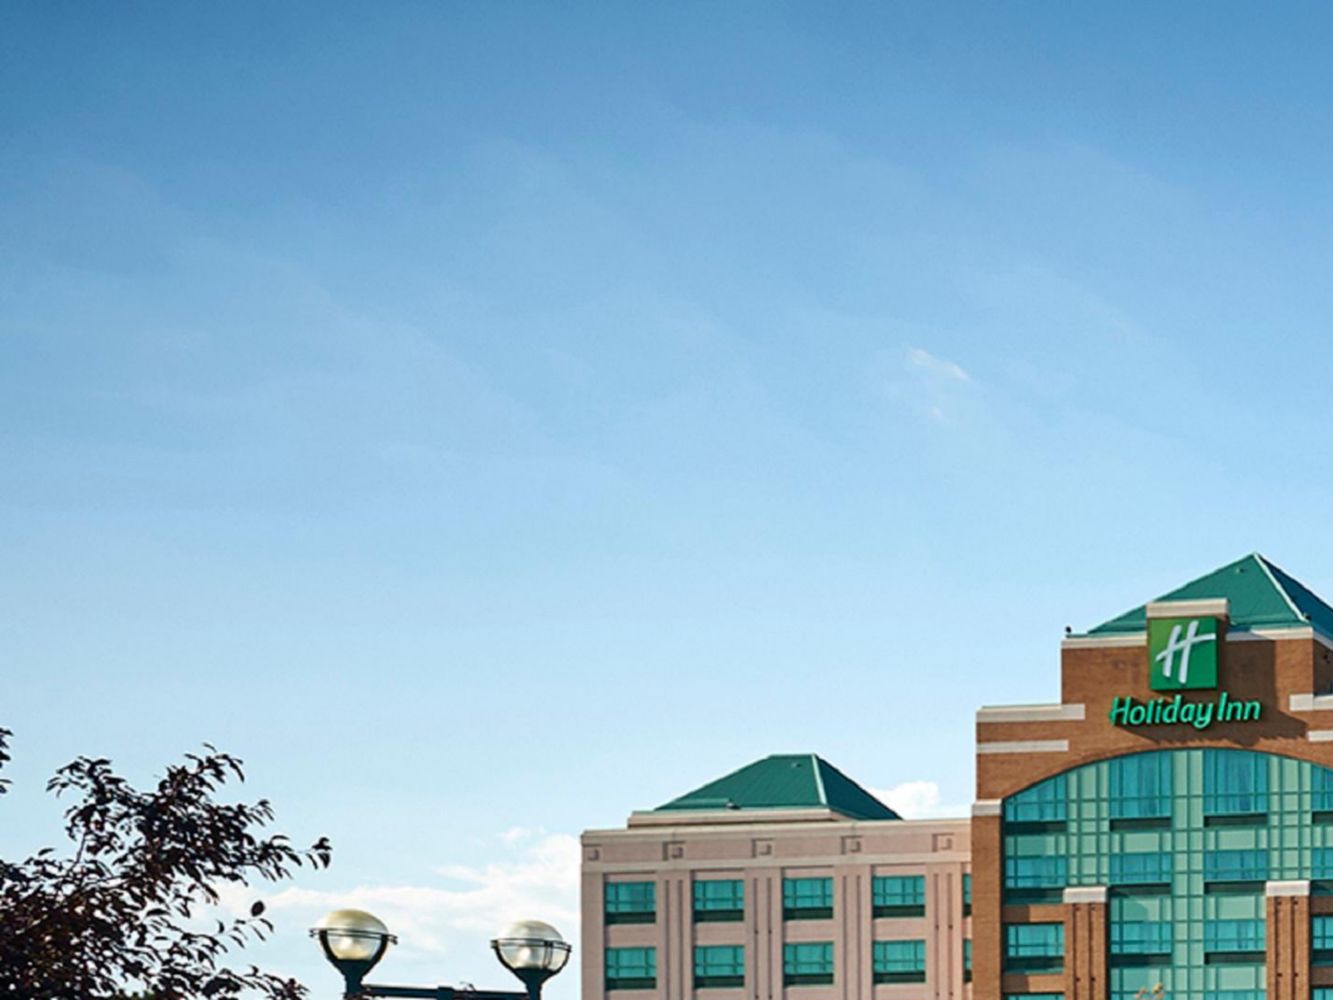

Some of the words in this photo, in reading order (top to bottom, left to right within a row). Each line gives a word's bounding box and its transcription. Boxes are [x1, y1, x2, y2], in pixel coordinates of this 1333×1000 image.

[1154, 619, 1217, 685] H
[1108, 693, 1214, 729] Holiday
[1216, 691, 1261, 722] Inn
